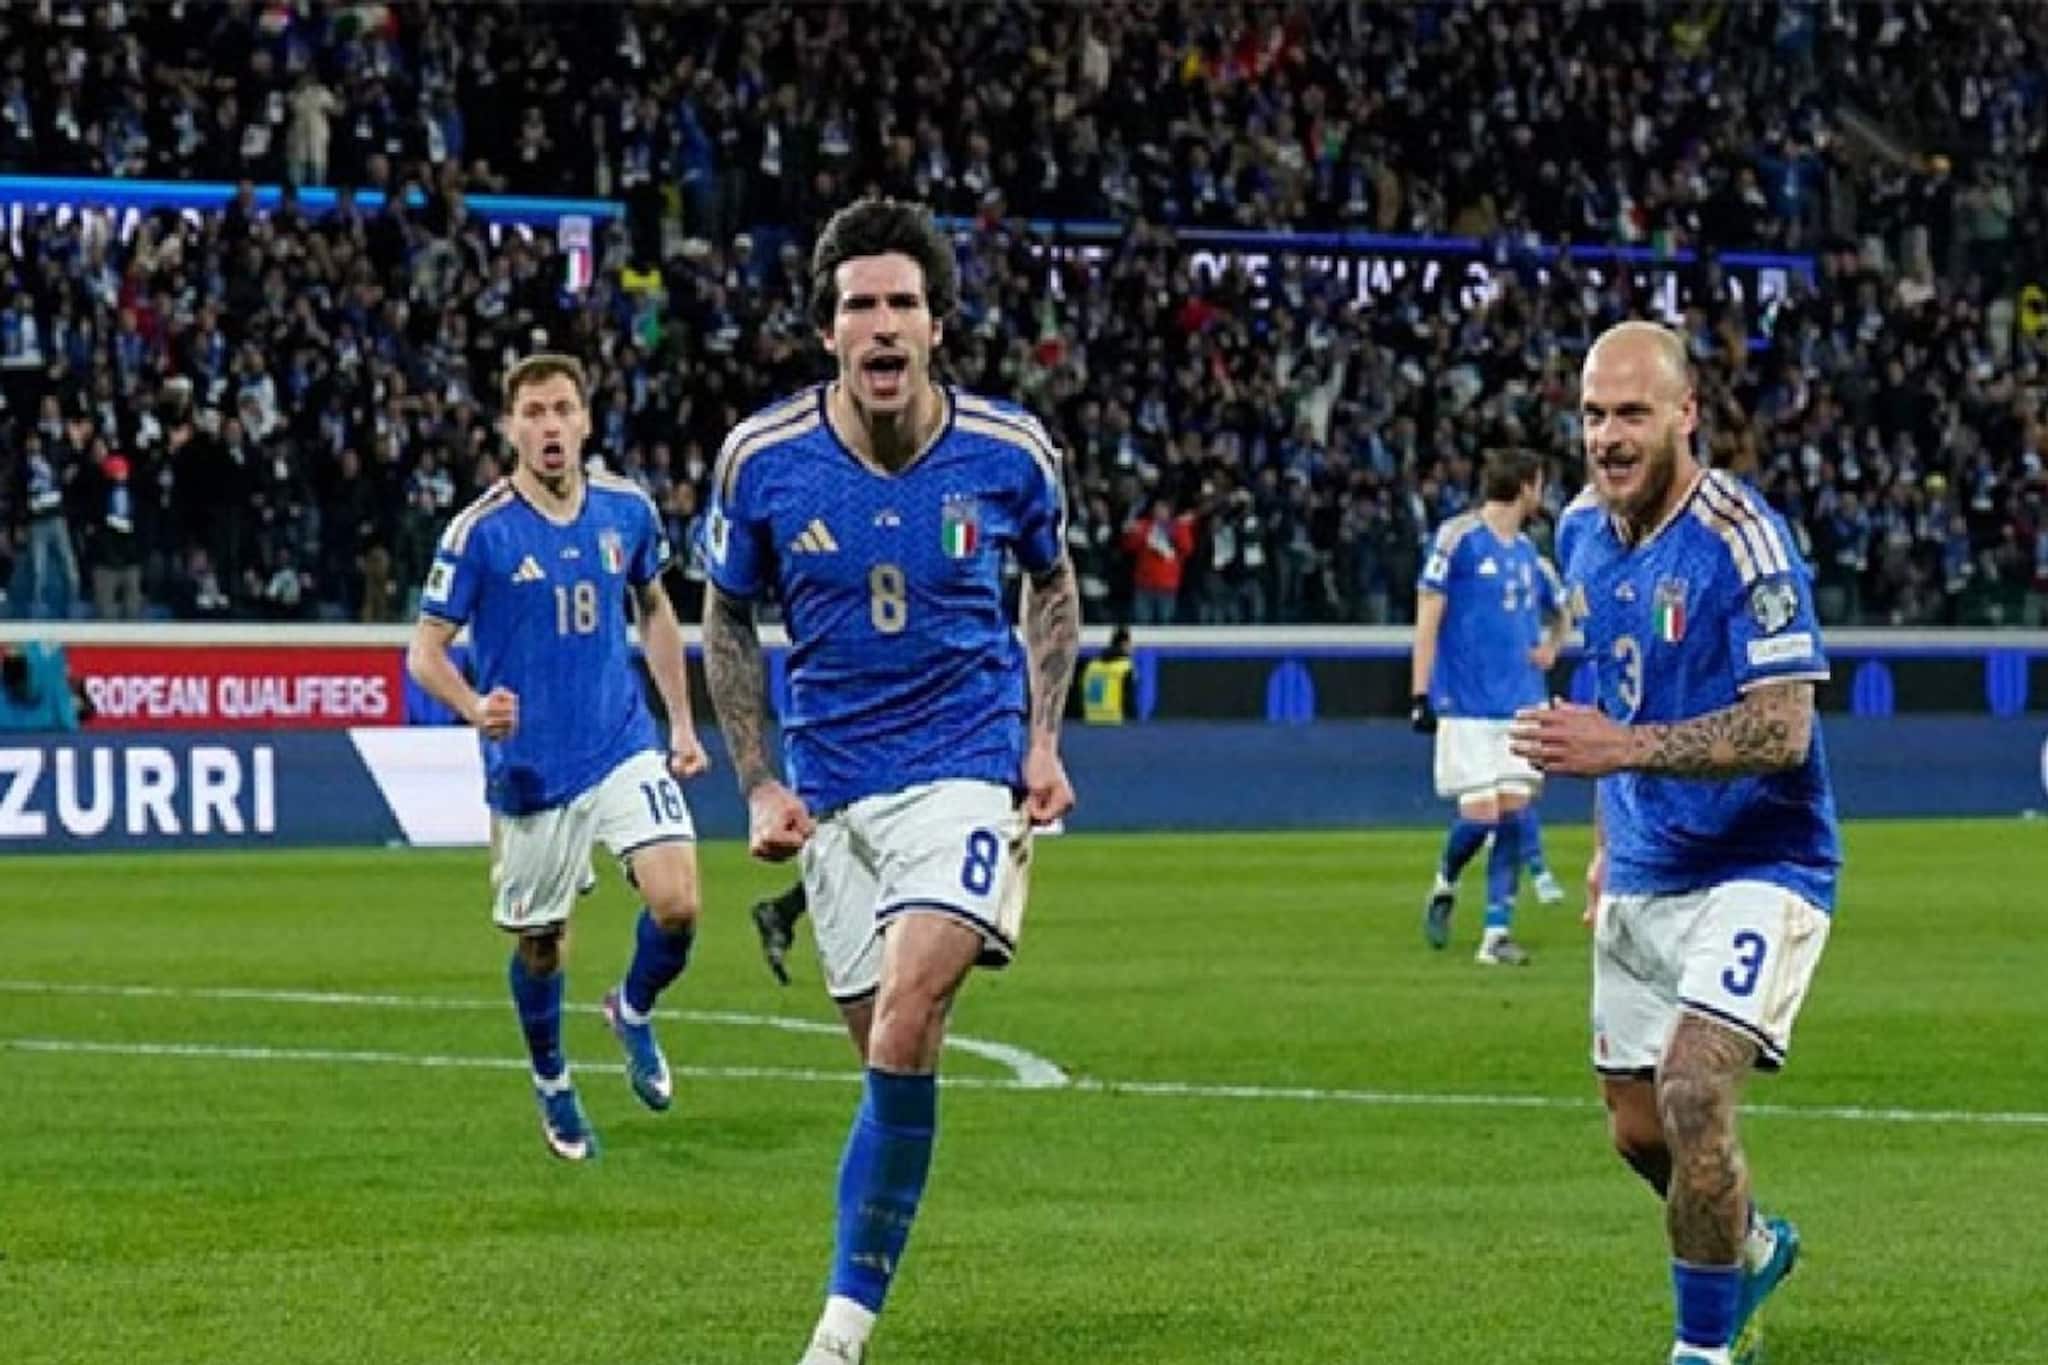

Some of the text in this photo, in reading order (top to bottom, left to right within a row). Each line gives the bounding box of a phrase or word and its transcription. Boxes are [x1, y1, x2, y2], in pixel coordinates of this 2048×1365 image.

[555, 581, 598, 635] 18
[871, 565, 906, 635] 8
[216, 675, 389, 717] QUALIFIERS
[0, 745, 276, 836] ZURRI
[961, 827, 999, 896] 8
[1721, 929, 1767, 996] 3
